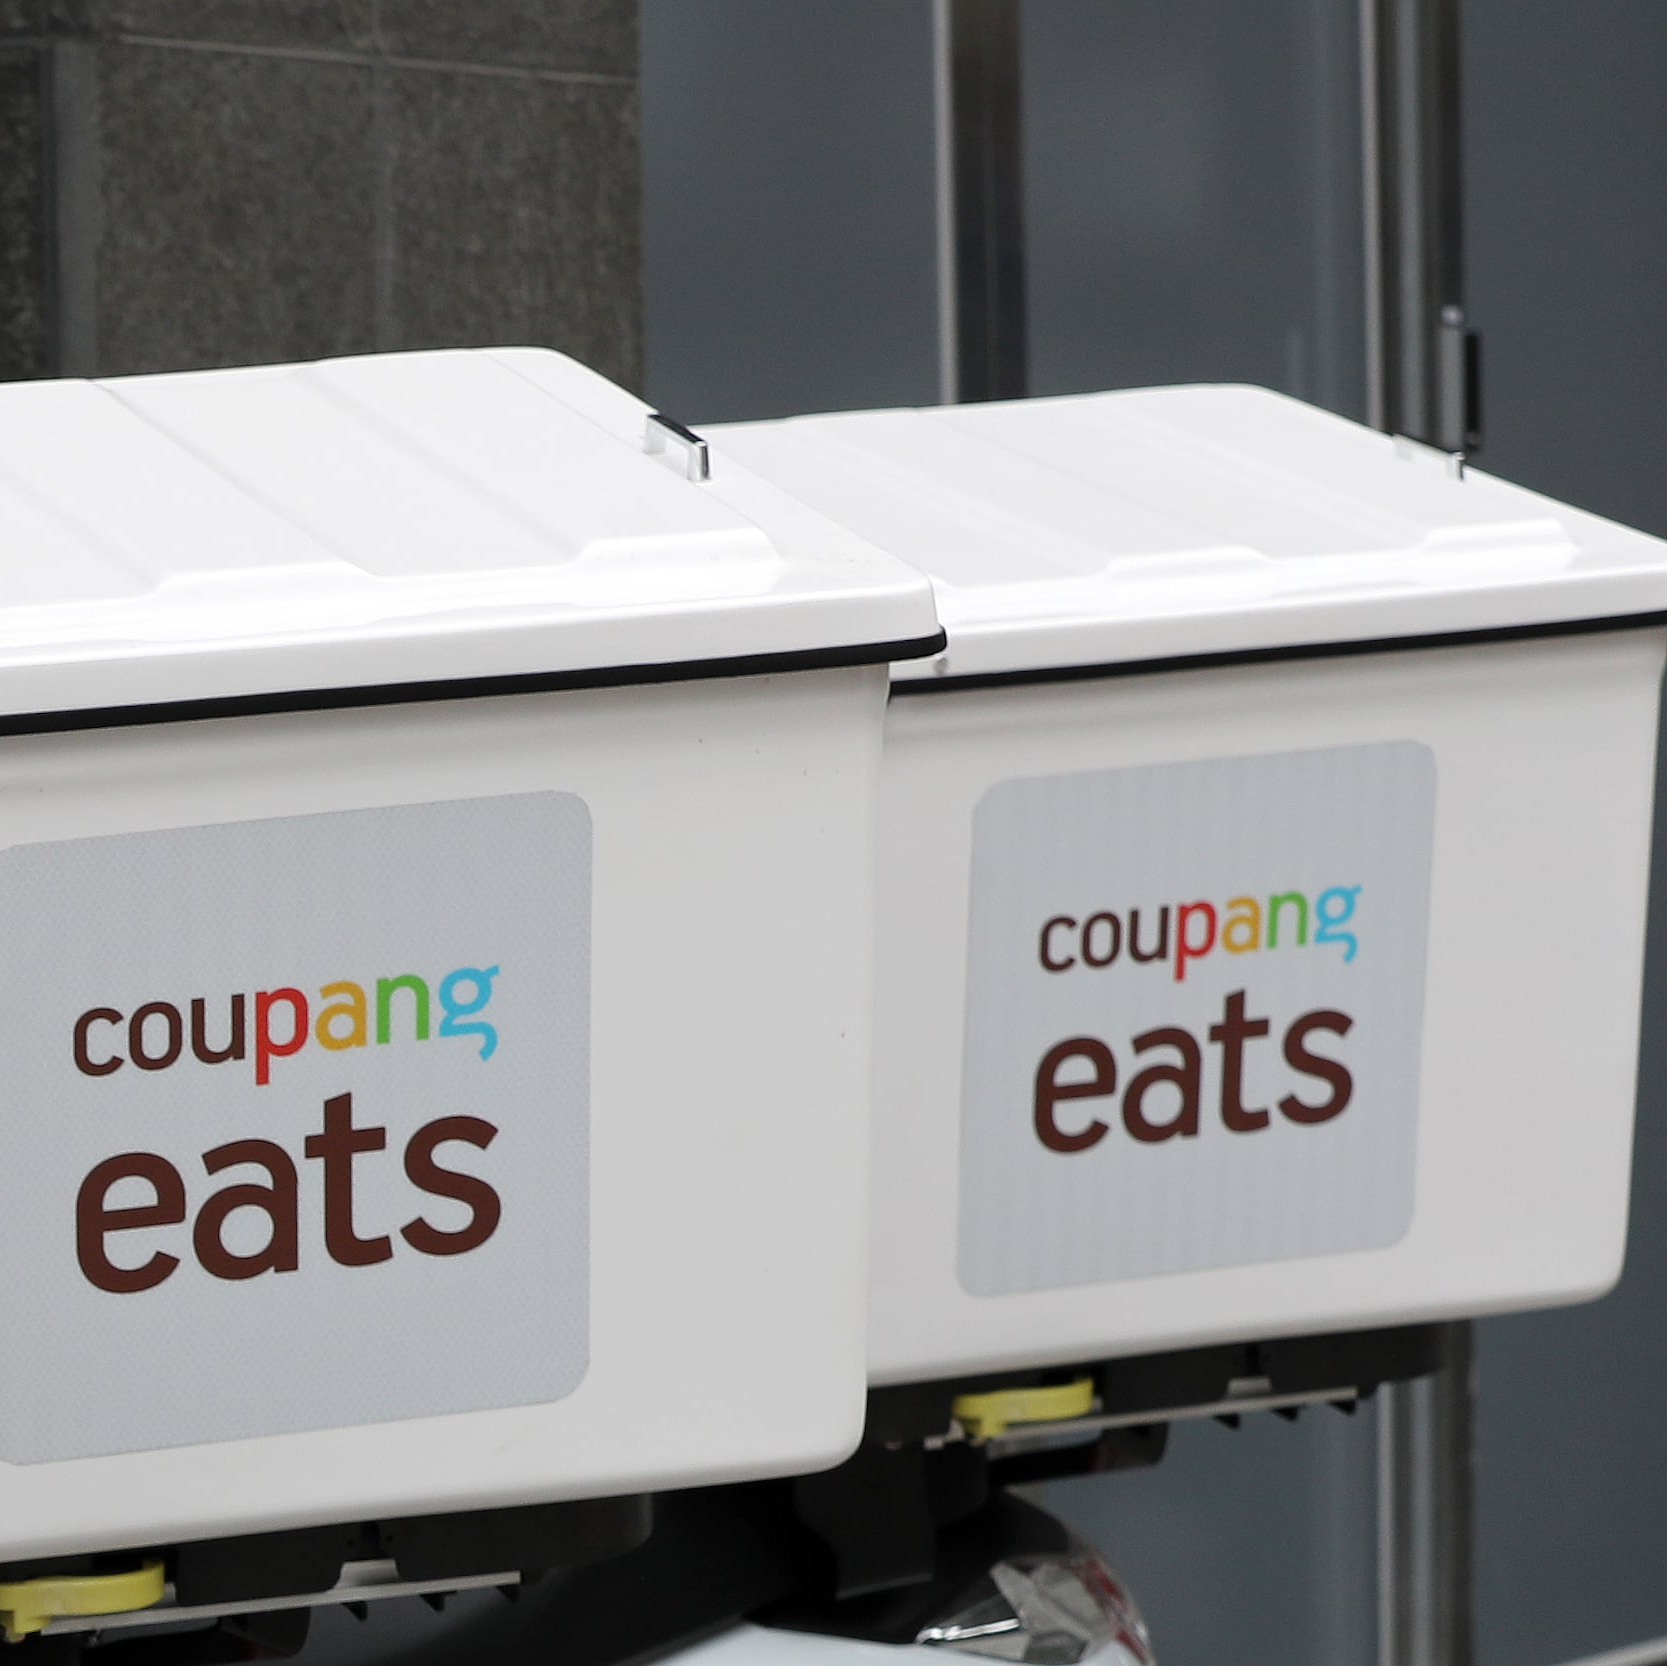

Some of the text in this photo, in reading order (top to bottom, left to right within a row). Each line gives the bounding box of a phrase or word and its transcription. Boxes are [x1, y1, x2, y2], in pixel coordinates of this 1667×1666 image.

[1038, 884, 1362, 982] coupang
[73, 964, 501, 1086] coupang
[1033, 987, 1354, 1154] eats
[75, 1091, 501, 1294] eats
